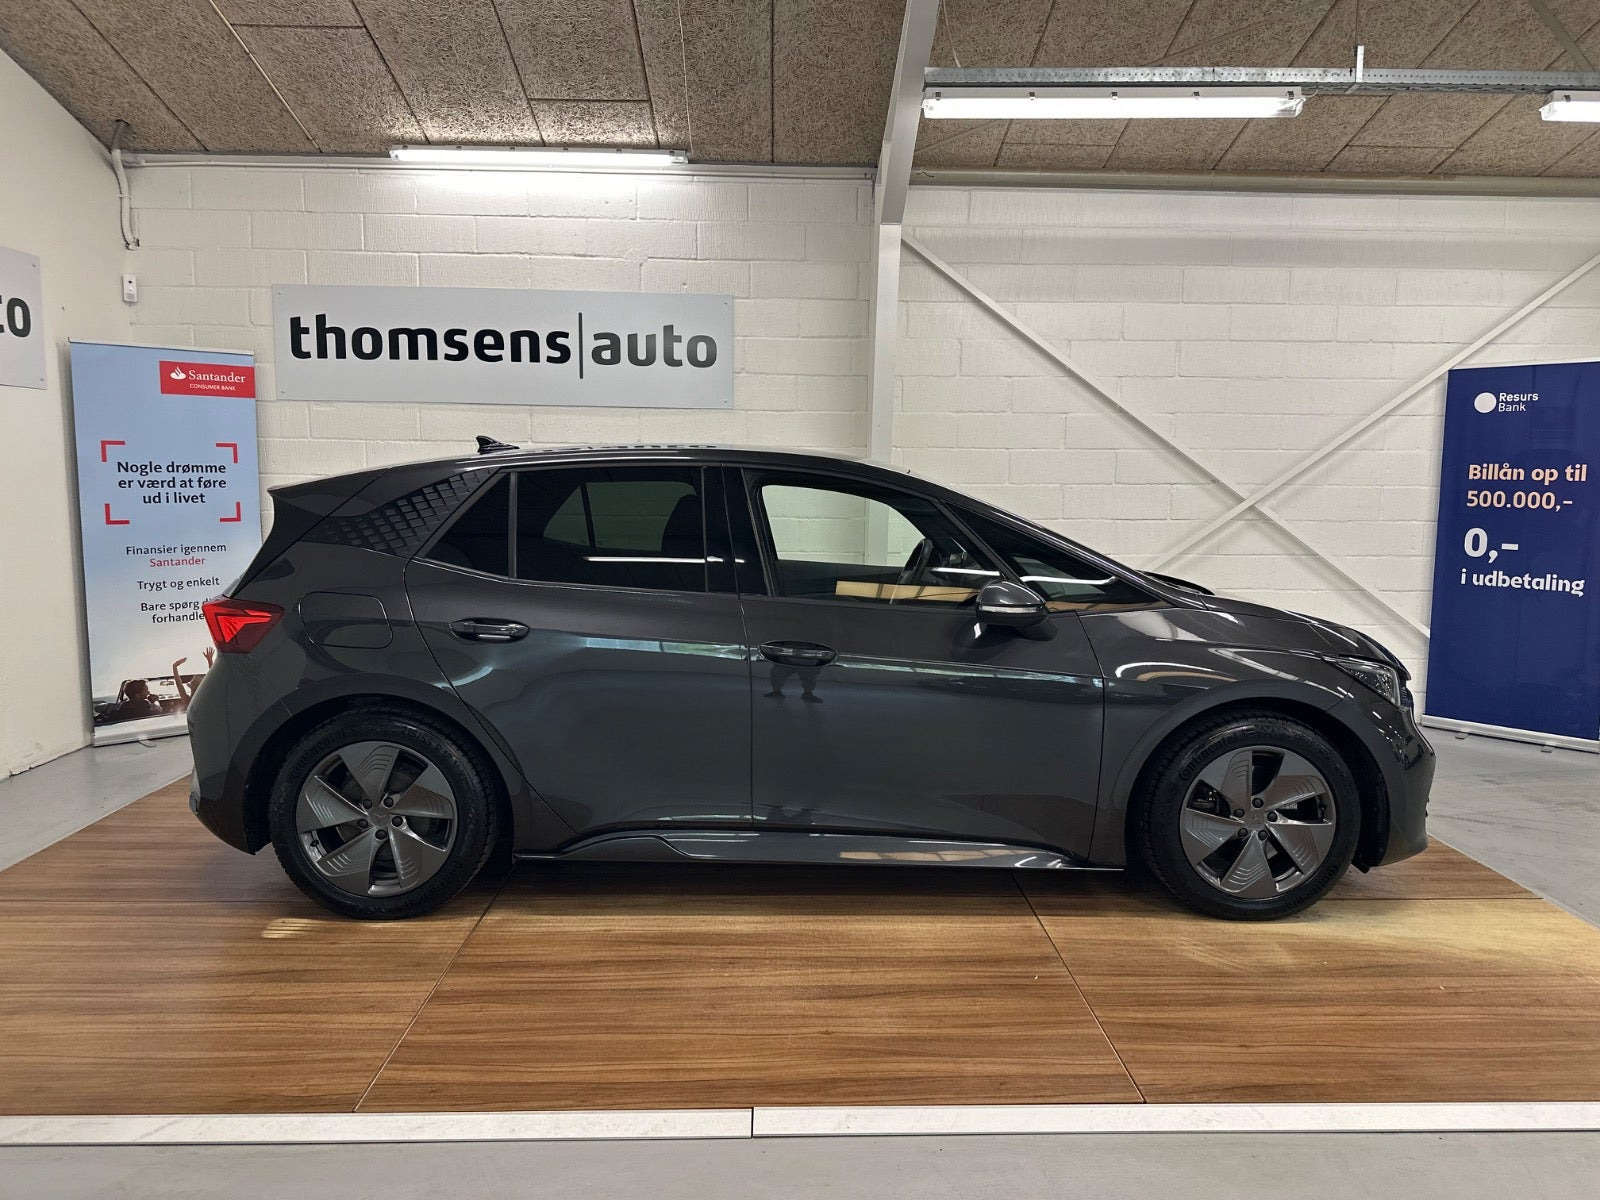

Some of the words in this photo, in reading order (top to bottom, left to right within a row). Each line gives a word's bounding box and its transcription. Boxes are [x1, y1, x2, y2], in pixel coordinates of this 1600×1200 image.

[290, 313, 571, 364] thomsens
[591, 324, 718, 369] auto
[188, 370, 246, 383] Santander
[189, 383, 220, 391] CONSUMER
[1498, 392, 1539, 402] Resurs
[1498, 402, 1527, 412] Bank
[117, 461, 163, 477] Nogle
[166, 461, 227, 474] drømme
[1468, 463, 1525, 480] Billån
[1531, 466, 1559, 486] op
[1564, 463, 1588, 482] til
[118, 478, 134, 489] er
[137, 476, 176, 489] værd
[179, 477, 195, 489] at
[198, 476, 227, 489] føre
[142, 492, 162, 504] ud
[165, 492, 170, 504] i
[174, 492, 206, 504] livet
[1466, 489, 1573, 513] 500.000,-
[126, 545, 177, 555] Finansier
[180, 544, 226, 555] igennem
[150, 556, 206, 567] Santander
[137, 580, 167, 592] Trygt
[170, 579, 184, 591] og
[186, 577, 220, 587] enkelt
[1460, 568, 1467, 585] i
[1472, 570, 1585, 597] udbetaling
[141, 602, 166, 611] Bare
[169, 601, 200, 612] spørg
